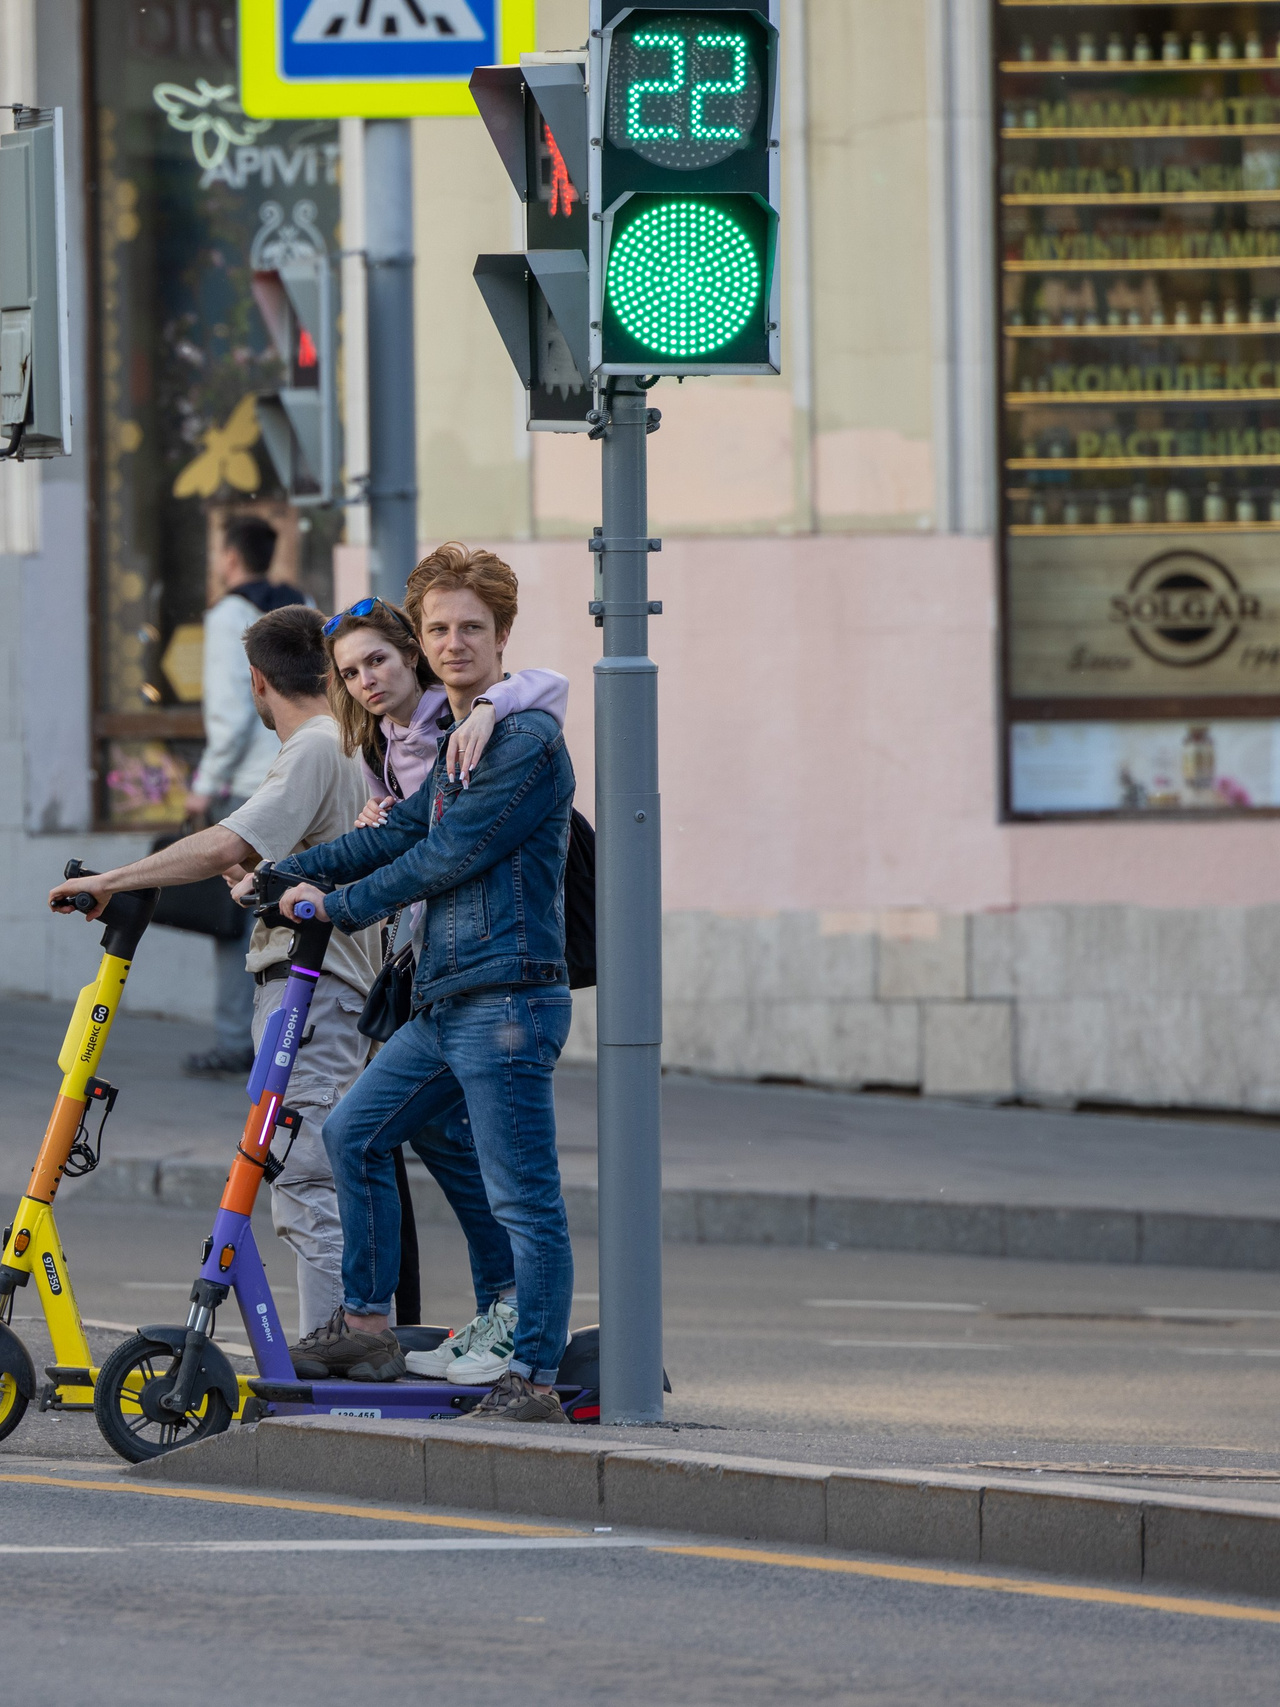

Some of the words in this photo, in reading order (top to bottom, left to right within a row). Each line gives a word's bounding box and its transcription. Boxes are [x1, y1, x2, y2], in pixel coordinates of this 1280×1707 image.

[627, 32, 746, 140] 22
[1077, 428, 1280, 457] РАСТЕНИЯ
[1109, 593, 1261, 623] SOLGAR
[81, 1025, 101, 1063] Яндекс
[93, 1006, 107, 1022] Go
[43, 1256, 60, 1291] 977350
